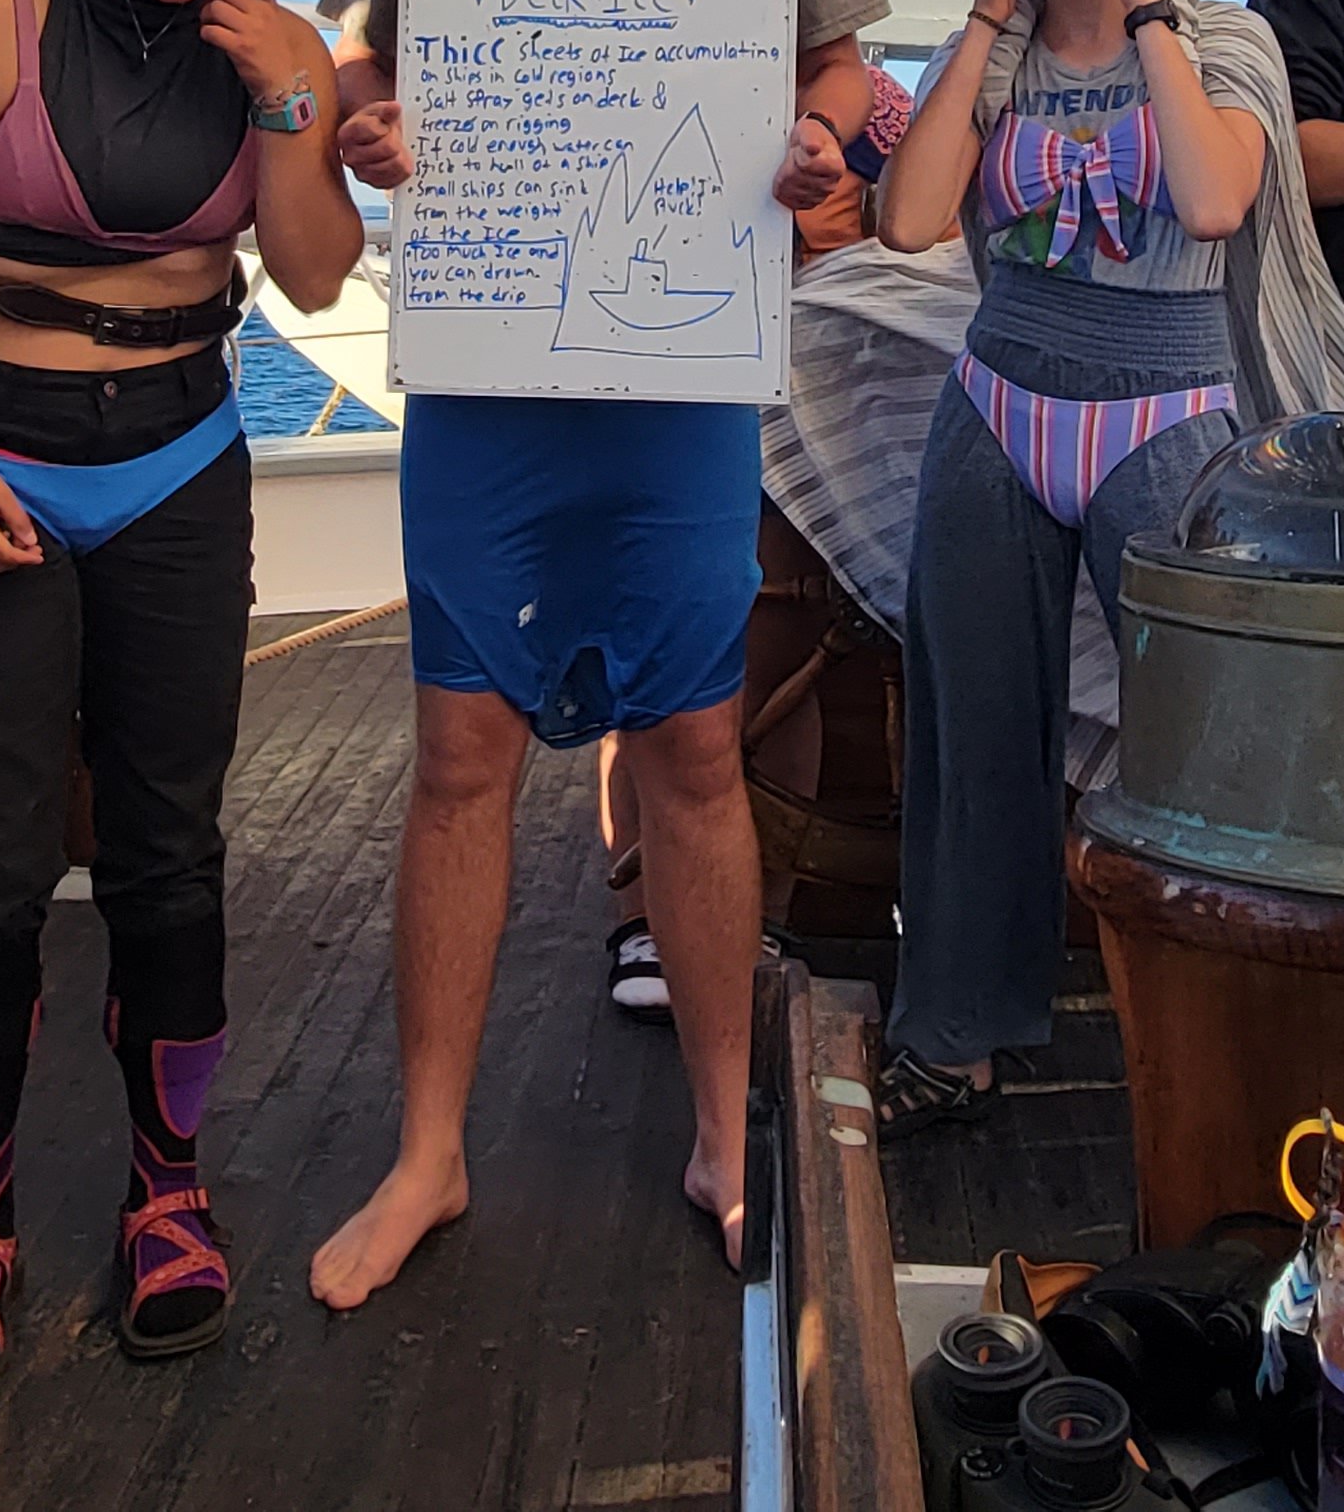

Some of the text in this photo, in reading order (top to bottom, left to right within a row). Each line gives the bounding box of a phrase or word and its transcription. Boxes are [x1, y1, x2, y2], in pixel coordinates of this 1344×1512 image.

[654, 40, 781, 62] accumulating
[489, 66, 505, 84] in
[549, 65, 617, 88] regions
[505, 113, 572, 135] rigging
[416, 136, 442, 161] If
[463, 158, 482, 172] to
[455, 203, 488, 221] the
[439, 225, 472, 242] the
[408, 265, 440, 283] you
[408, 286, 527, 305] from the drip
